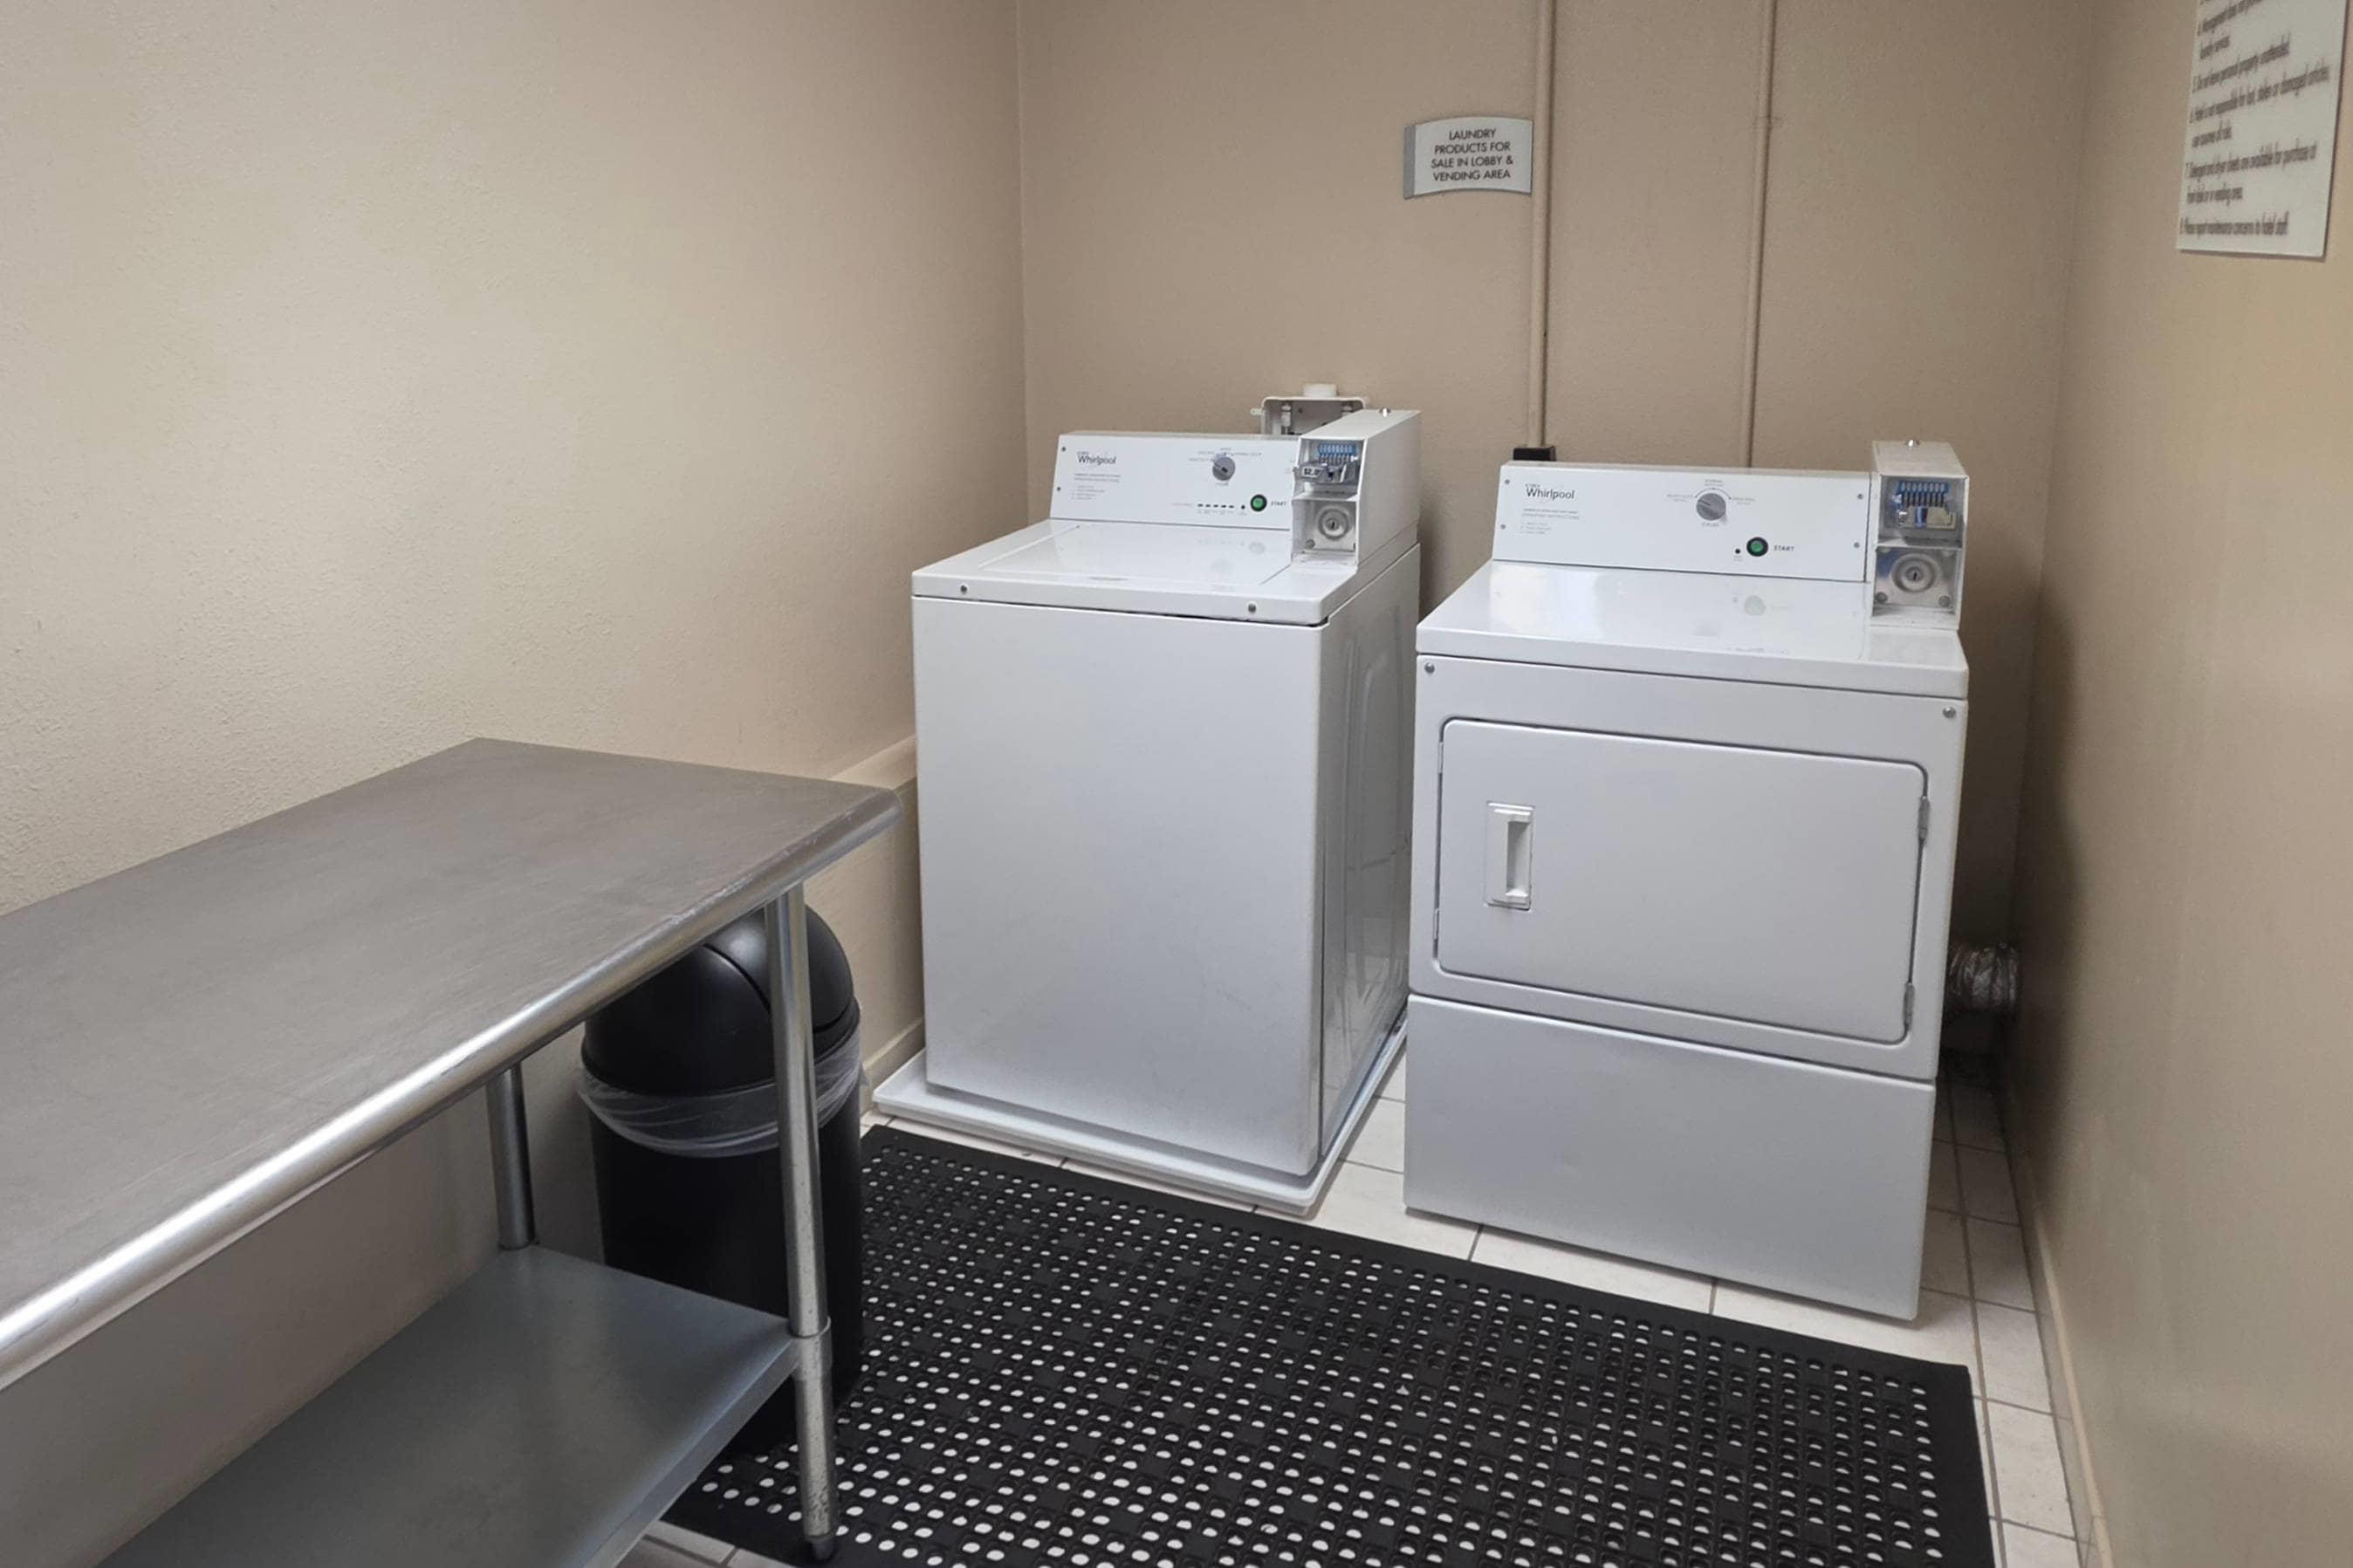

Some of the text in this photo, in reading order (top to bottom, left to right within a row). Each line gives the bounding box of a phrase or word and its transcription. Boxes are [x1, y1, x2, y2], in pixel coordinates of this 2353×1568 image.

[1449, 128, 1496, 140] LAUNDRY
[1434, 141, 1511, 154] PRODUCTS FOR
[1430, 155, 1513, 168] SALE IN LOBBY &
[1433, 169, 1511, 181] VENDING AREA
[1077, 455, 1117, 466] Whirlpool
[1526, 488, 1574, 501] Whirlpool
